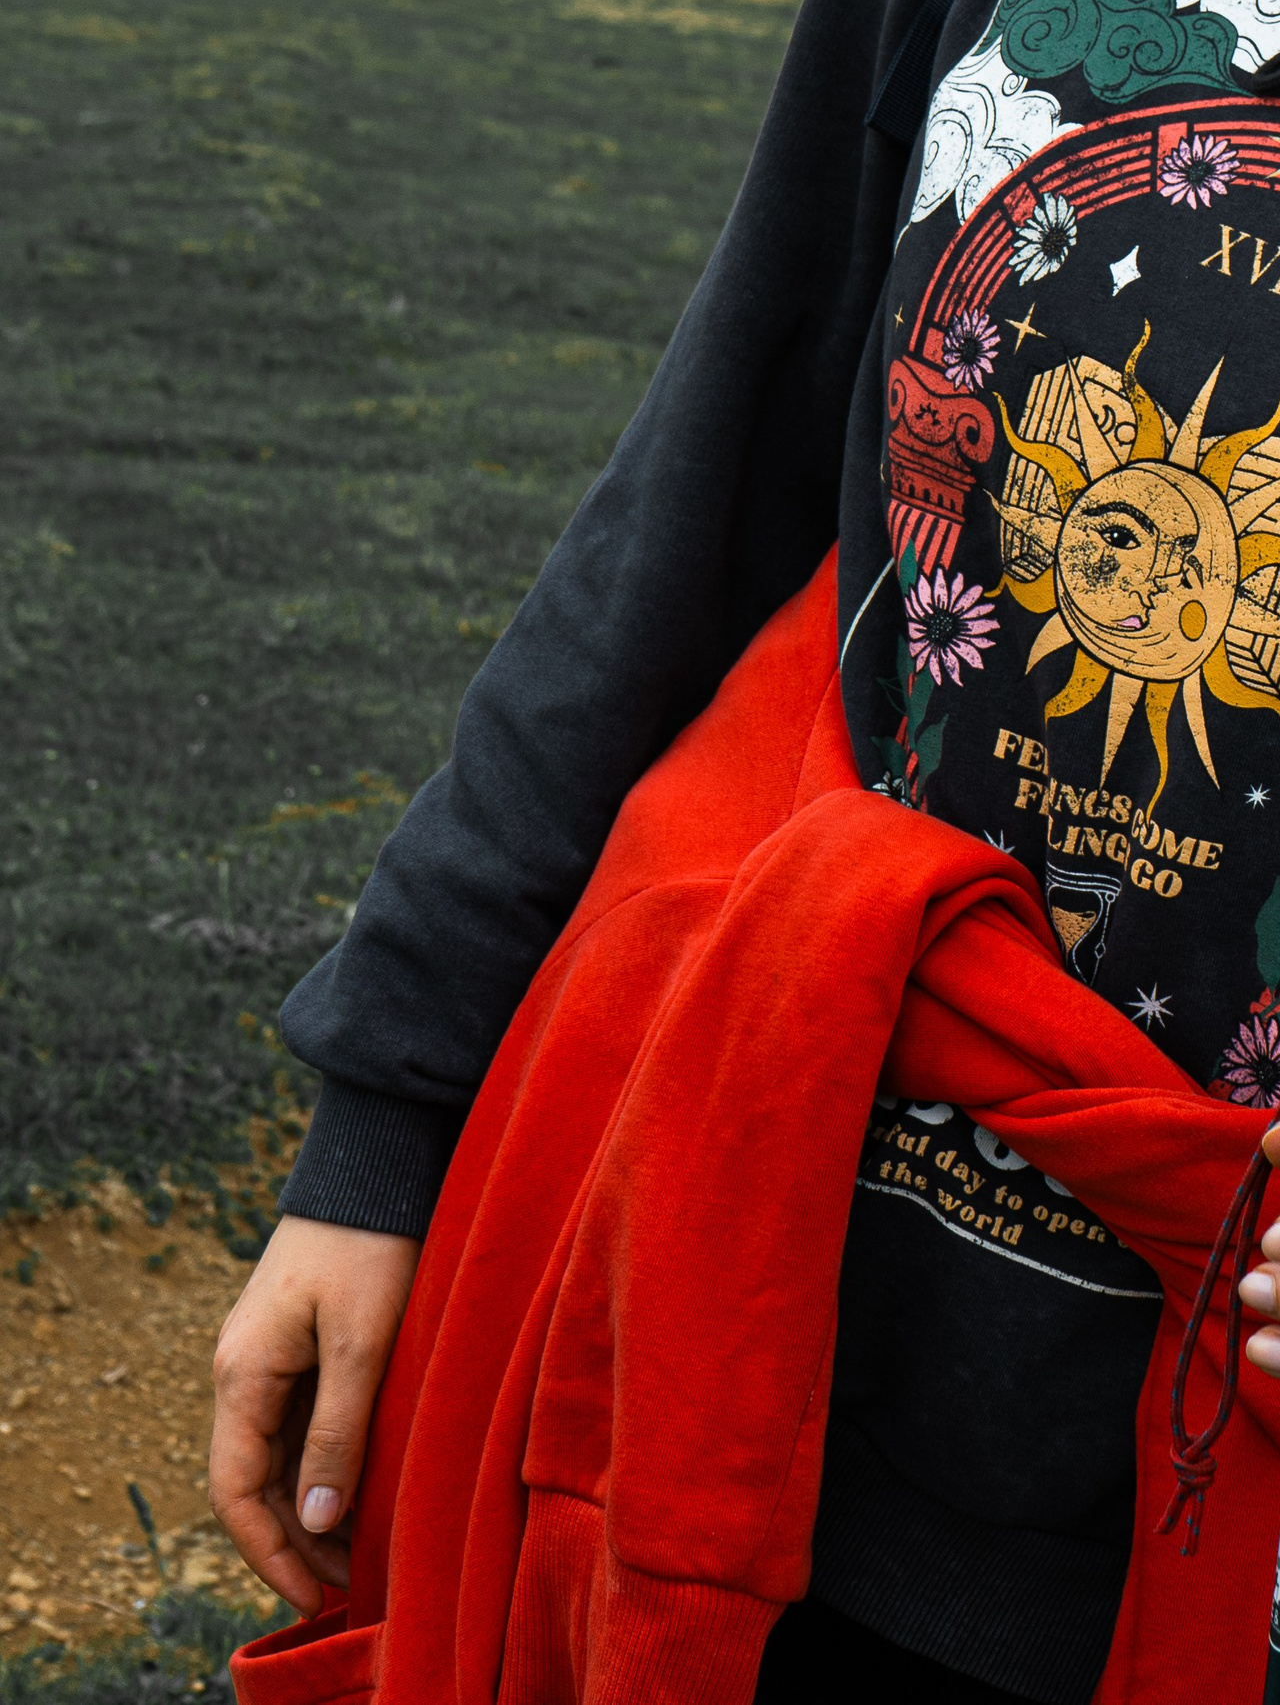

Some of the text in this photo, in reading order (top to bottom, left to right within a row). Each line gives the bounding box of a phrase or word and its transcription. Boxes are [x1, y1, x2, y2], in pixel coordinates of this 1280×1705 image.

[1131, 858, 1183, 898] GO
[880, 1160, 1024, 1245] the world
[935, 1150, 986, 1195] day
[995, 1186, 1023, 1212] to
